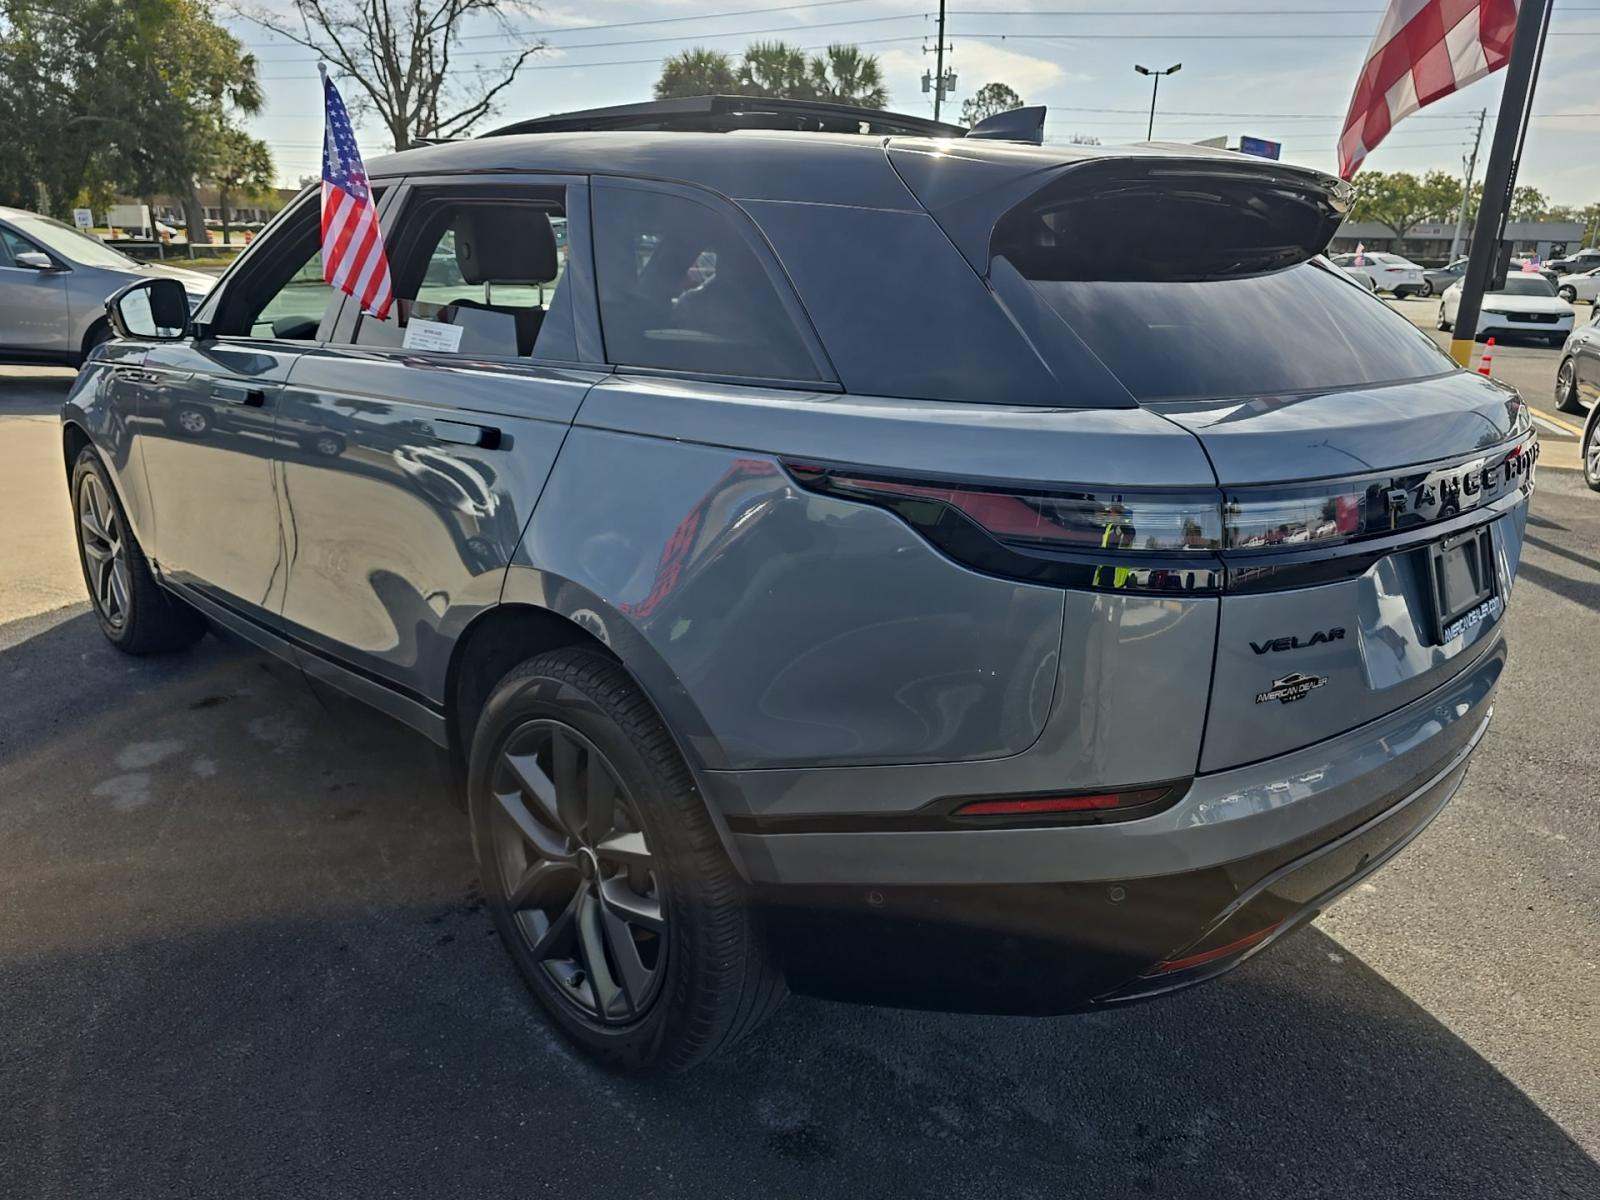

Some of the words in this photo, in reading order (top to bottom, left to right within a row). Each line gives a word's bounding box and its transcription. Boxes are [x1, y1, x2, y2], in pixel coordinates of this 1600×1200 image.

[1249, 626, 1346, 655] VELAR
[1256, 686, 1299, 704] AMERICAN
[1299, 677, 1329, 692] DEALER
